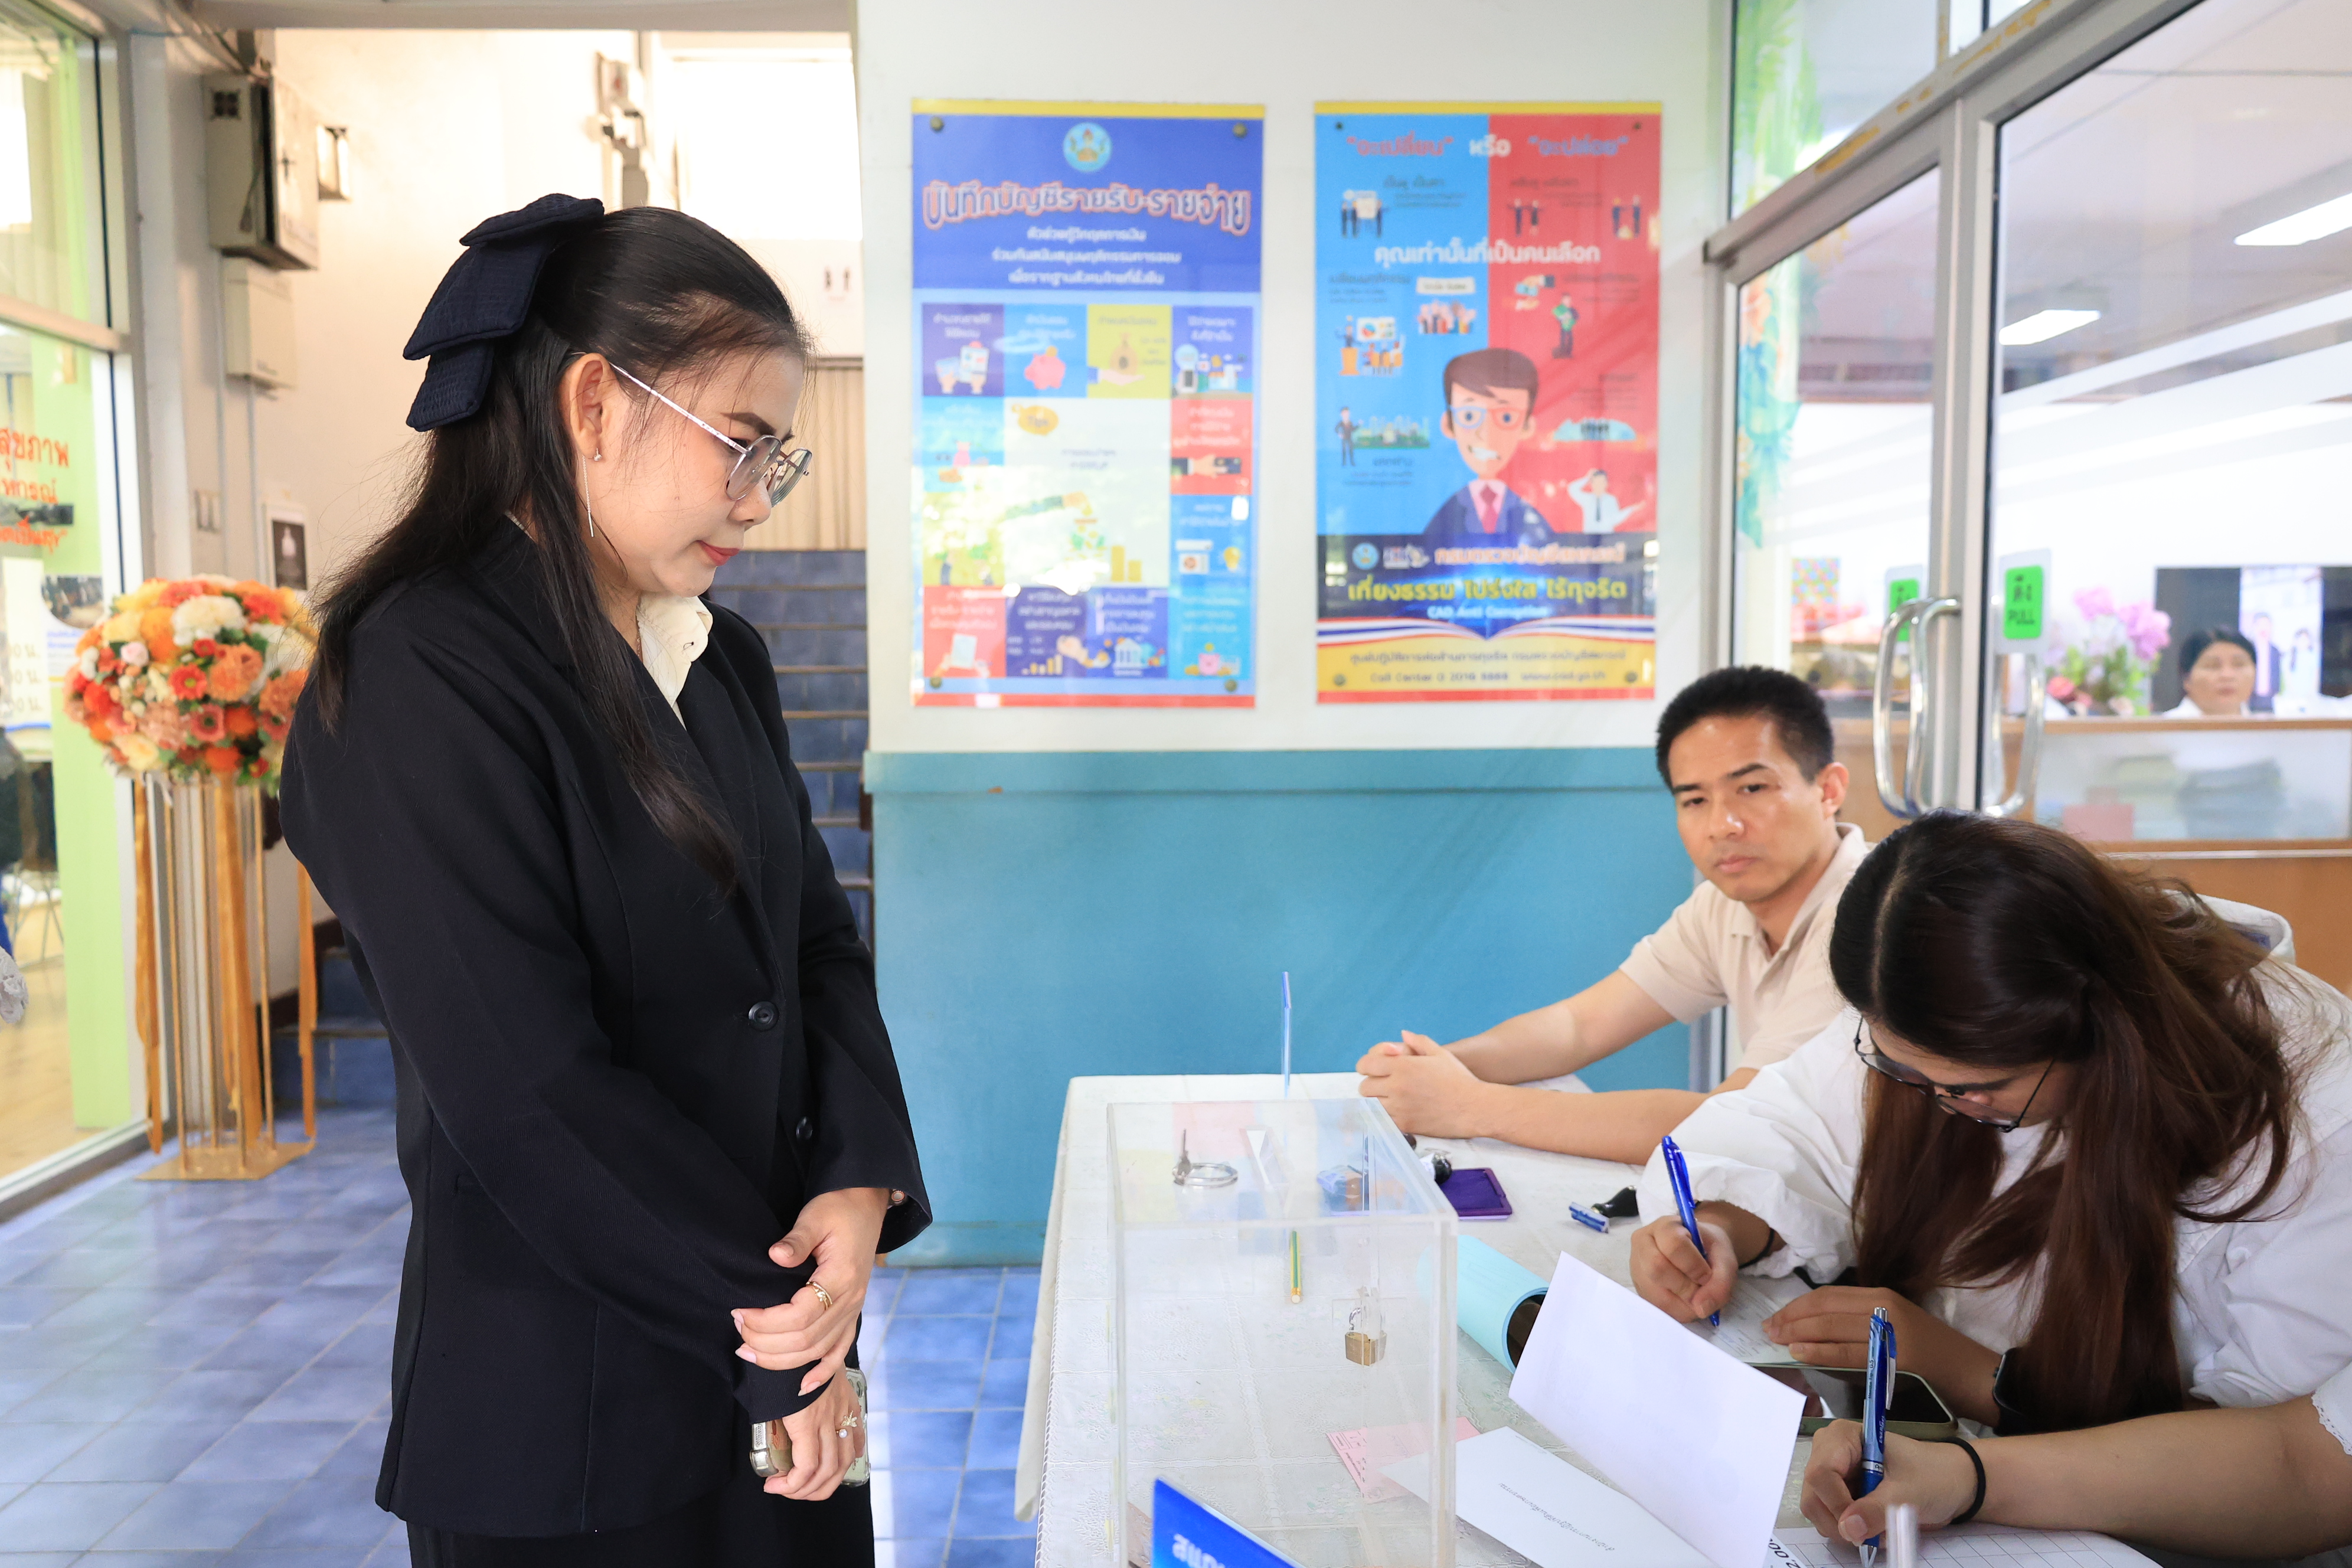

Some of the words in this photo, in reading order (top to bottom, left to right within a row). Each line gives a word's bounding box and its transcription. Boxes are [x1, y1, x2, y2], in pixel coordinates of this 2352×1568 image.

[1348, 574, 1455, 601] เที่ยงธรรม
[1464, 578, 1537, 600] โปร่งใส
[1546, 575, 1627, 605] ไร้ทุจริต
